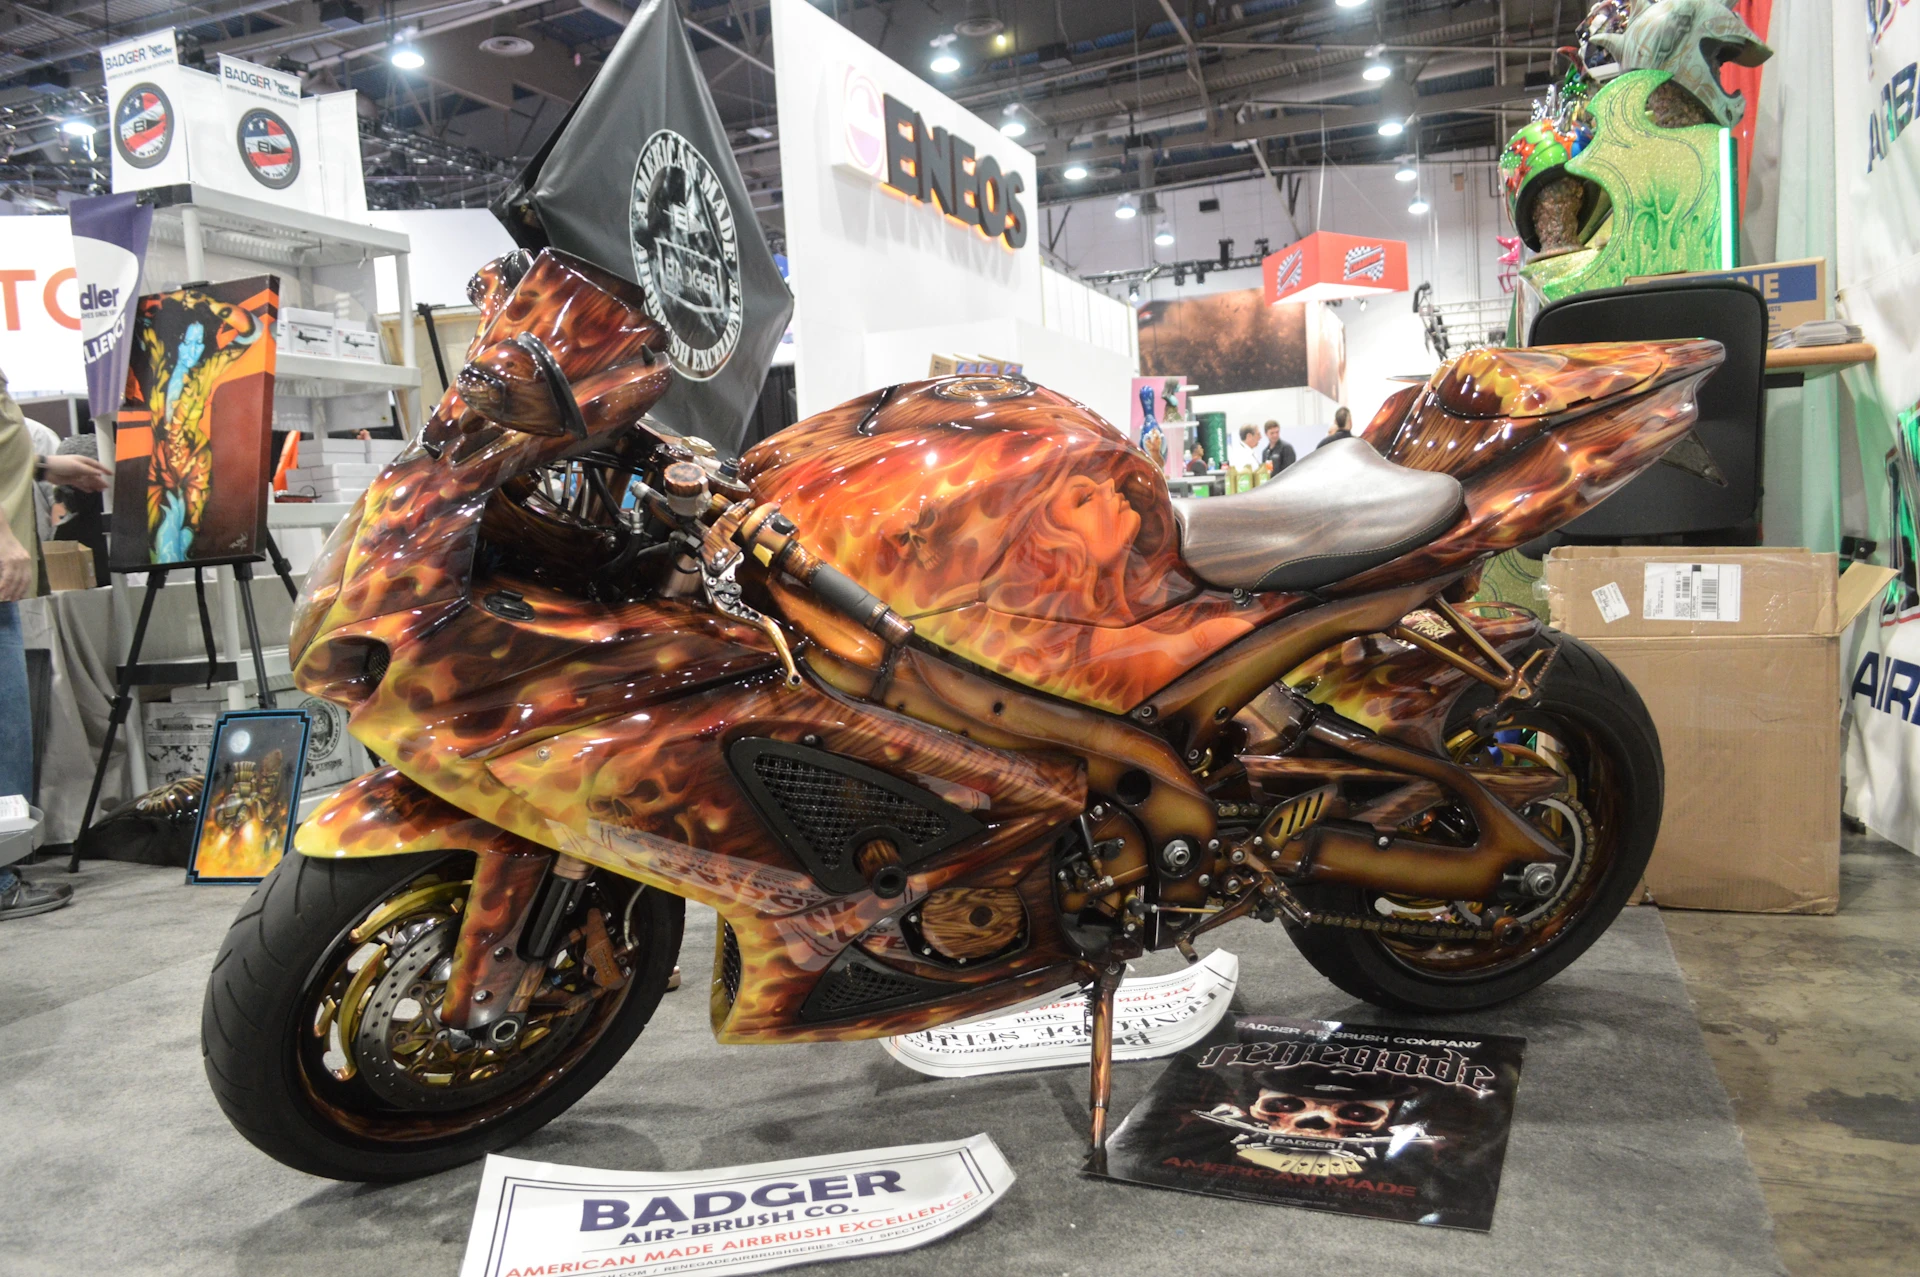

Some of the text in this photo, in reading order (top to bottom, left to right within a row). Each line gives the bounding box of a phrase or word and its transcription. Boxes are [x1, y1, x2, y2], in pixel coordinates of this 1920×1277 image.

[105, 47, 147, 71] BADGER
[224, 65, 272, 91] BADGER
[883, 92, 1027, 249] ENEOS
[699, 168, 738, 262] MADE
[83, 312, 126, 365] LLENC
[690, 278, 741, 371] EXCELLENCE
[1852, 651, 1920, 725] AIR
[1164, 982, 1197, 997] Are
[1015, 1013, 1065, 1025] Spirit
[1234, 1020, 1301, 1036] BADGER
[1393, 1036, 1482, 1049] COMPANY
[929, 1044, 1014, 1055] AIRBRUSH
[1018, 1037, 1088, 1049] BADGER
[1198, 1041, 1496, 1098] renegade
[1273, 1137, 1336, 1149] BADGER
[1161, 1156, 1317, 1185] AMERICAN
[1324, 1173, 1417, 1198] MADE
[579, 1169, 906, 1232] BADGER
[505, 1190, 975, 1277] AMERICAN MADE AIRBRUSH EXCELLENCE
[618, 1203, 860, 1246] AIR-BRUSH CO.
